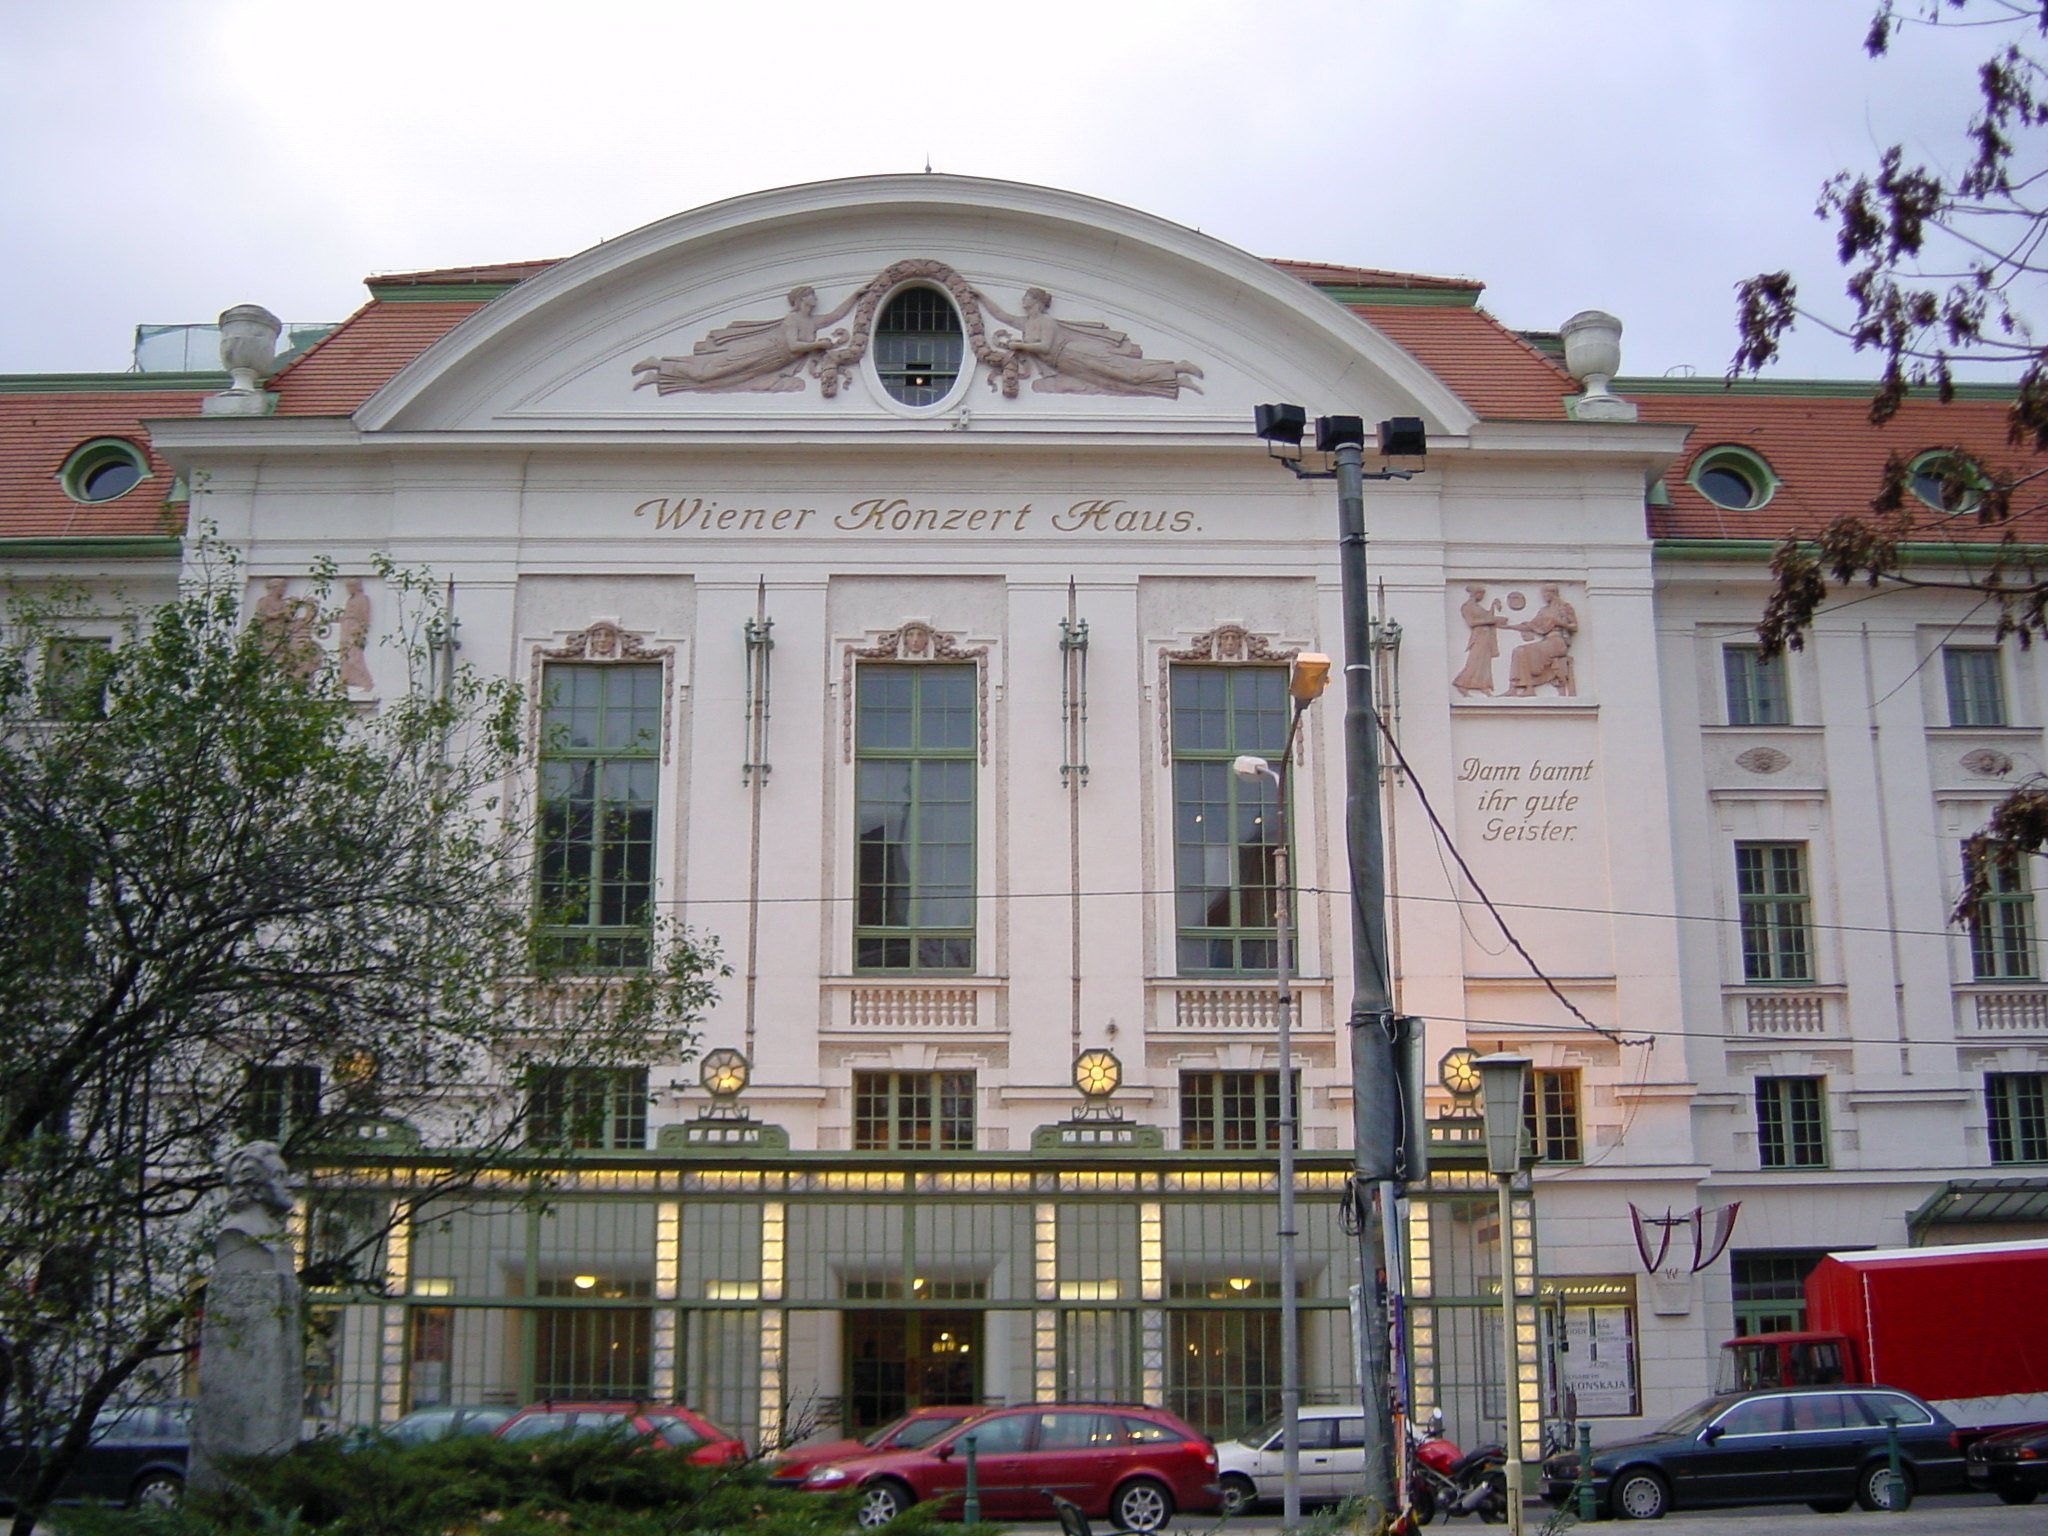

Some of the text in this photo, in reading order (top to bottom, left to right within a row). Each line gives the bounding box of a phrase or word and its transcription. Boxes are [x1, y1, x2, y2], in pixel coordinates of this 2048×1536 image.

[634, 498, 1204, 533] Wiener Konzert Haus.
[1457, 757, 1594, 782] Dann bannt
[1477, 788, 1580, 819] ihr gute
[1482, 818, 1578, 842] Geister.
